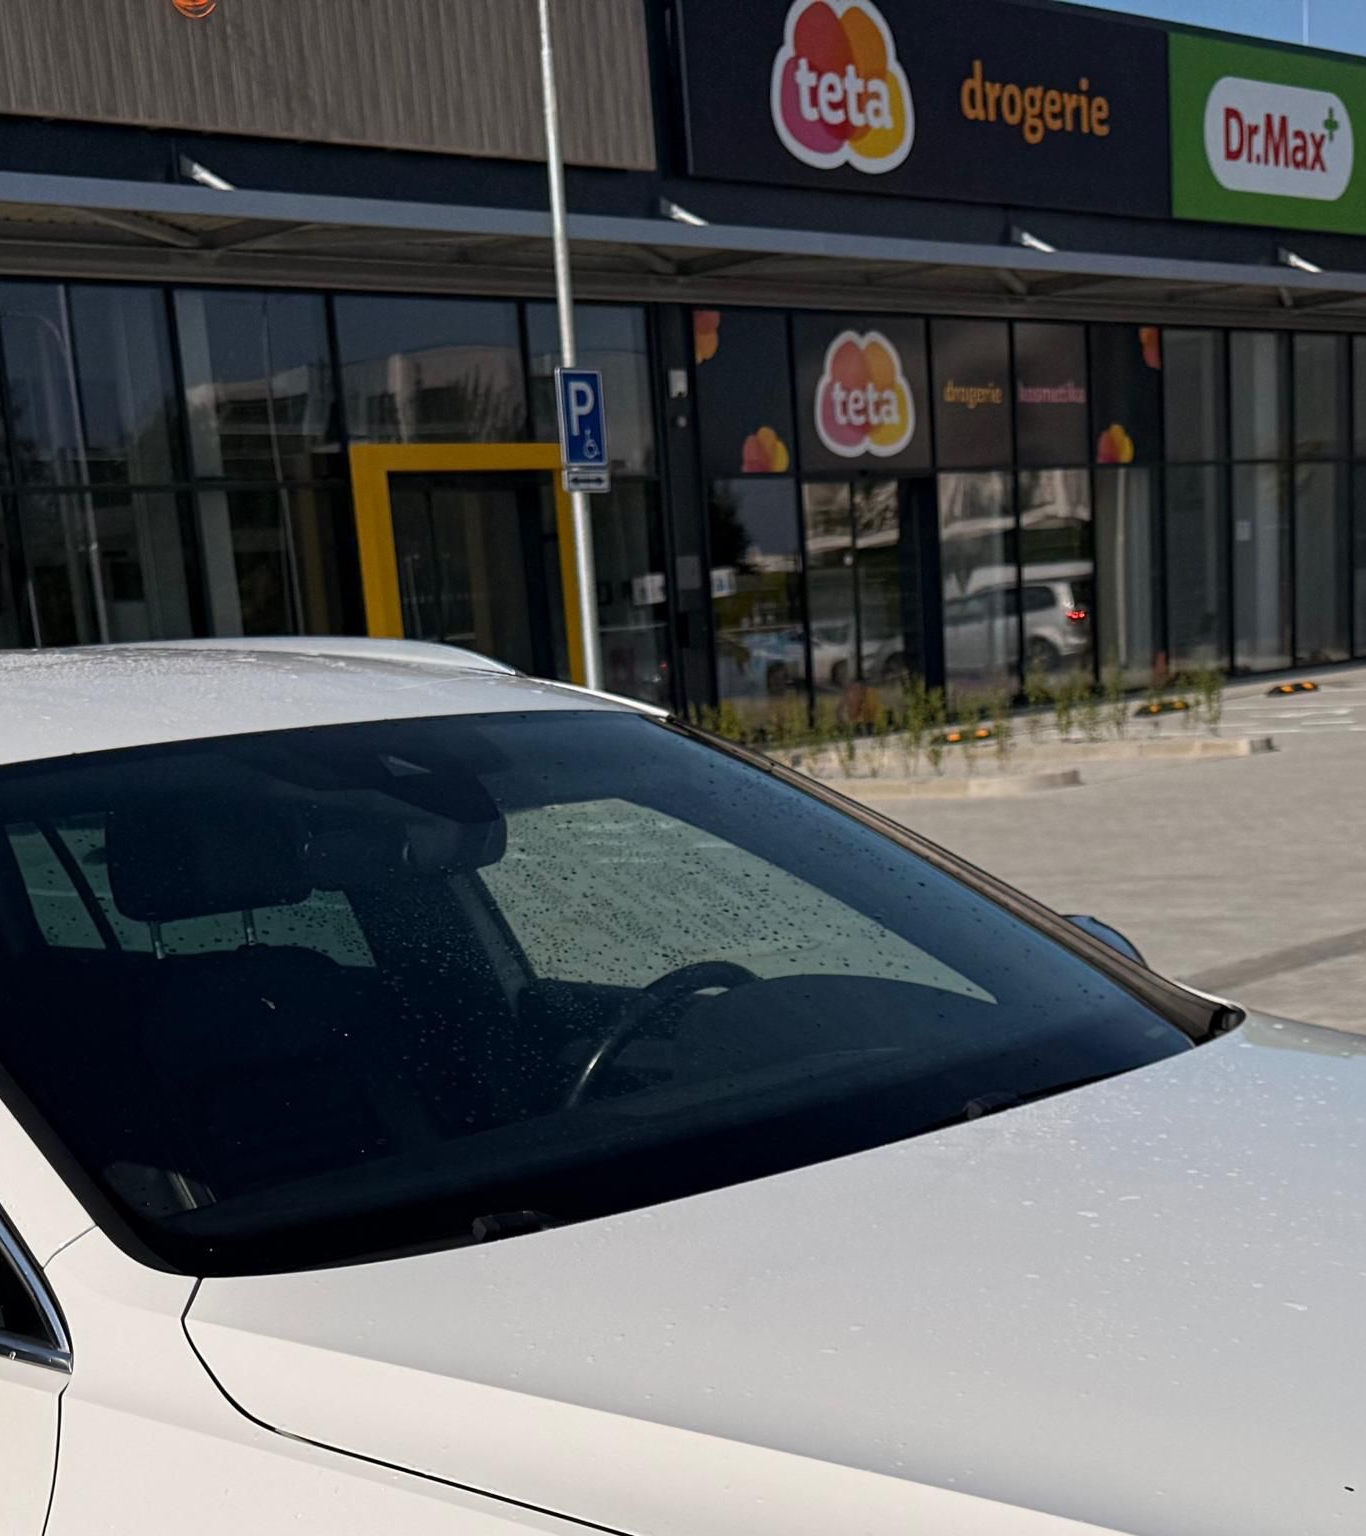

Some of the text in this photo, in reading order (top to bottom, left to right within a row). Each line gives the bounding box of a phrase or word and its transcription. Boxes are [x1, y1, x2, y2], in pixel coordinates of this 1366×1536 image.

[795, 58, 894, 128] teta
[961, 60, 1110, 144] drogerie
[568, 381, 595, 436] P
[834, 382, 900, 425] teta
